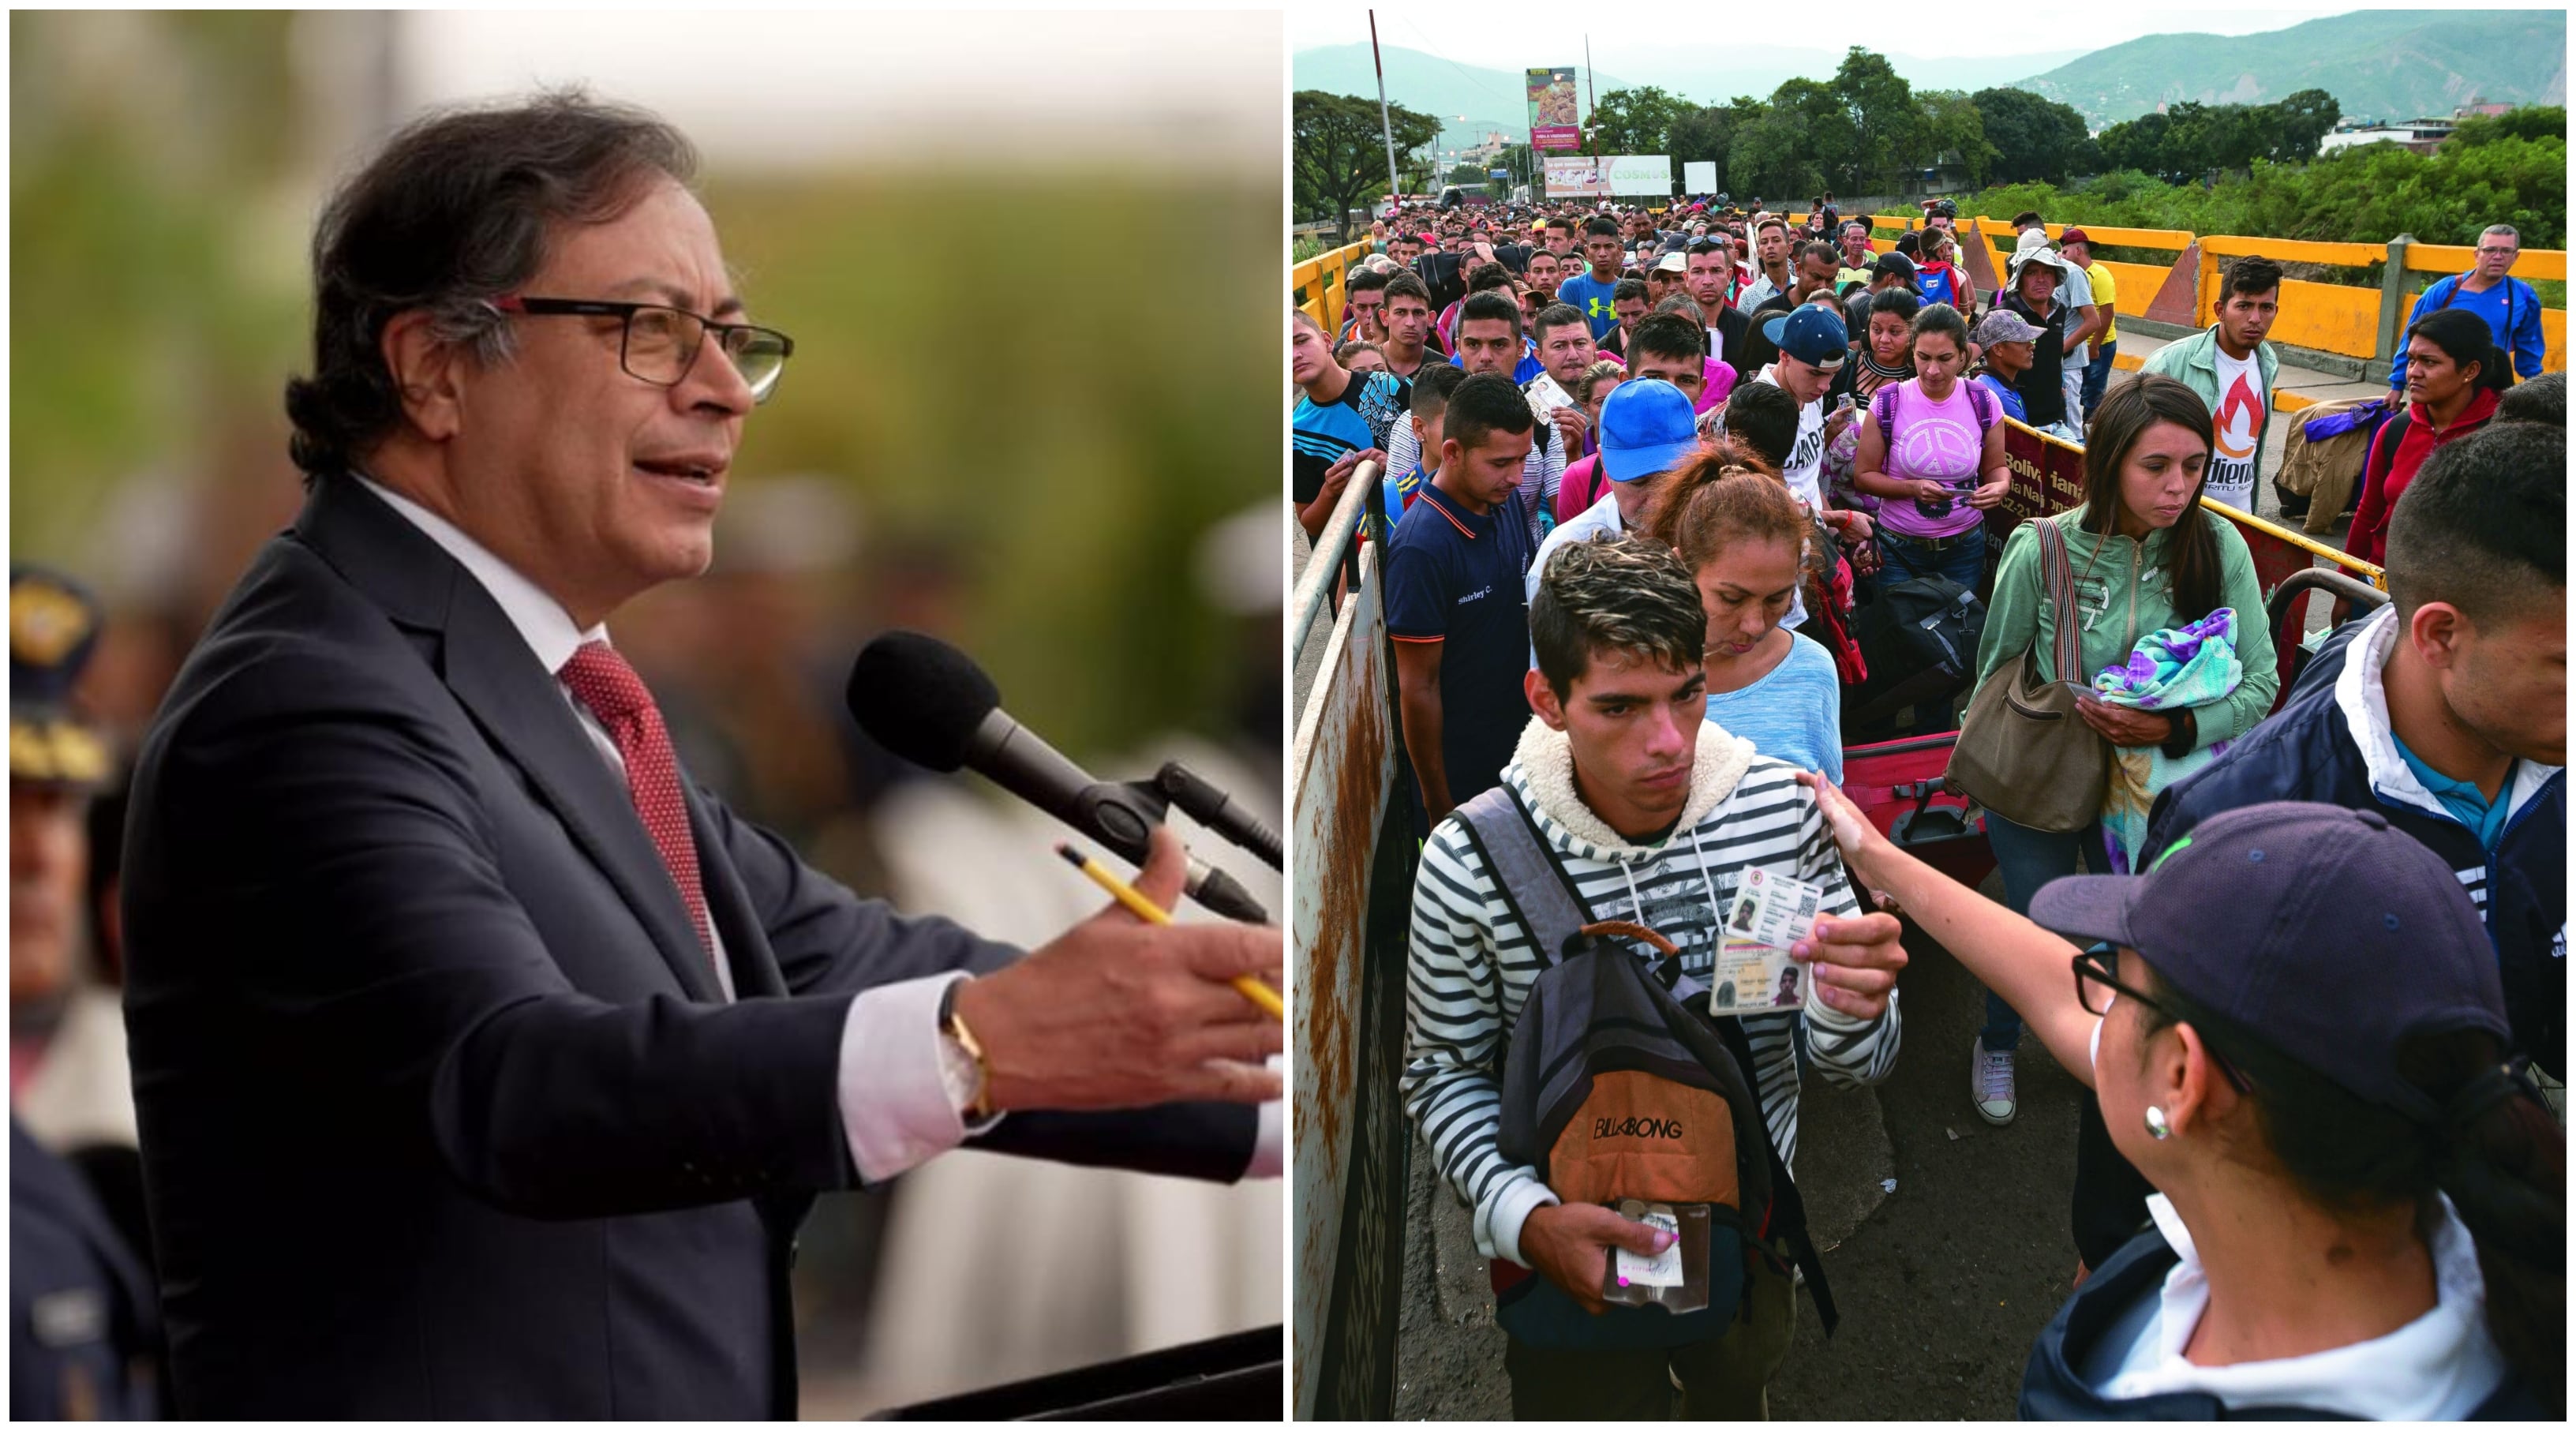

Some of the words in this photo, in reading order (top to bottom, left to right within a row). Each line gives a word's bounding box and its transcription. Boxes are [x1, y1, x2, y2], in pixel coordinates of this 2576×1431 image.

[2207, 458, 2255, 485] dien
[1458, 590, 1485, 605] Shirley
[1593, 1116, 1683, 1140] BILLABONG
